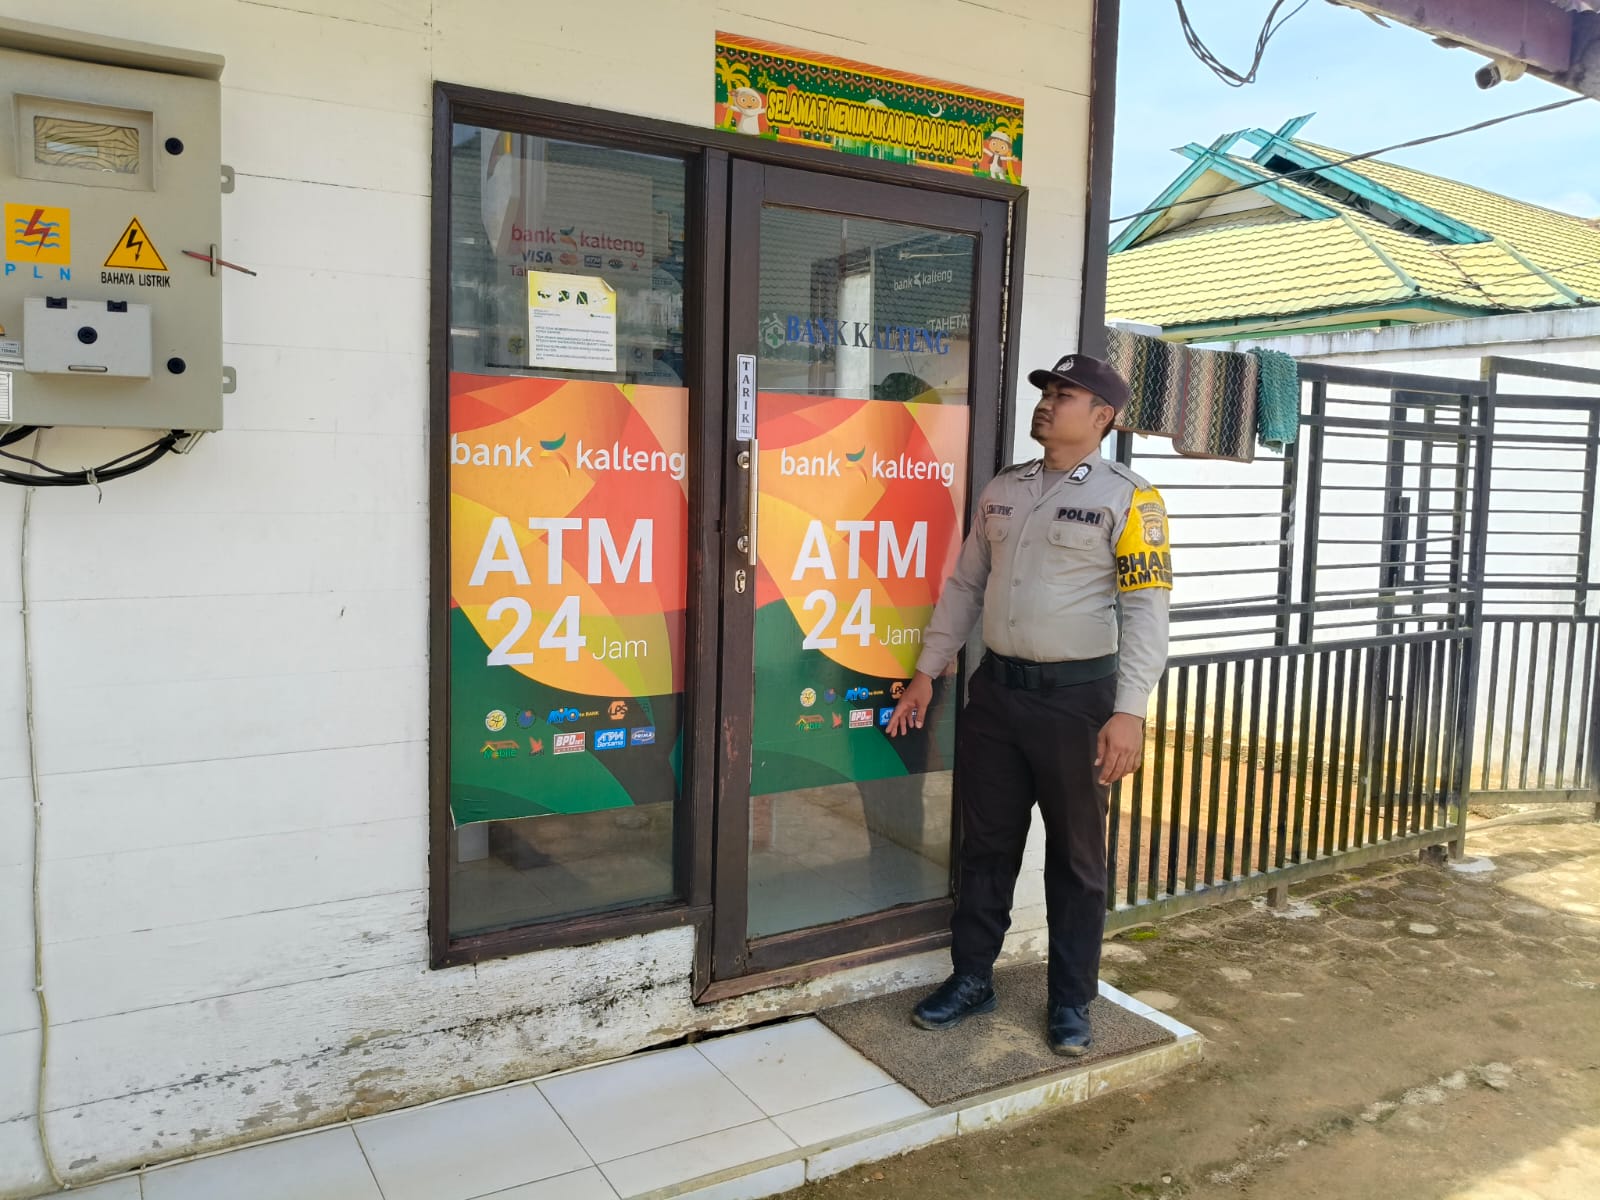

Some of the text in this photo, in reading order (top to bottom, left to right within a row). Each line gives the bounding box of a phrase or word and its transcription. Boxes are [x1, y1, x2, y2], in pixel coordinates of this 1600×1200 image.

[767, 88, 983, 159] SELAMAT MENUNAIKAN IBADAH PUASA
[511, 223, 645, 258] bank kalteng
[522, 250, 553, 264] VISA
[101, 272, 171, 288] BAHAYA LISTRIK
[893, 269, 953, 290] bank kalteng
[786, 314, 949, 355] BANK KALTENG
[741, 361, 751, 424] TARIK
[450, 432, 687, 481] bank kalteng
[780, 447, 956, 488] bank kalteng
[1057, 508, 1101, 525] POLRI
[468, 516, 654, 586] ATM
[790, 519, 928, 581] ATM
[486, 595, 648, 666] 24 Jam
[802, 588, 921, 650] 24 Jam
